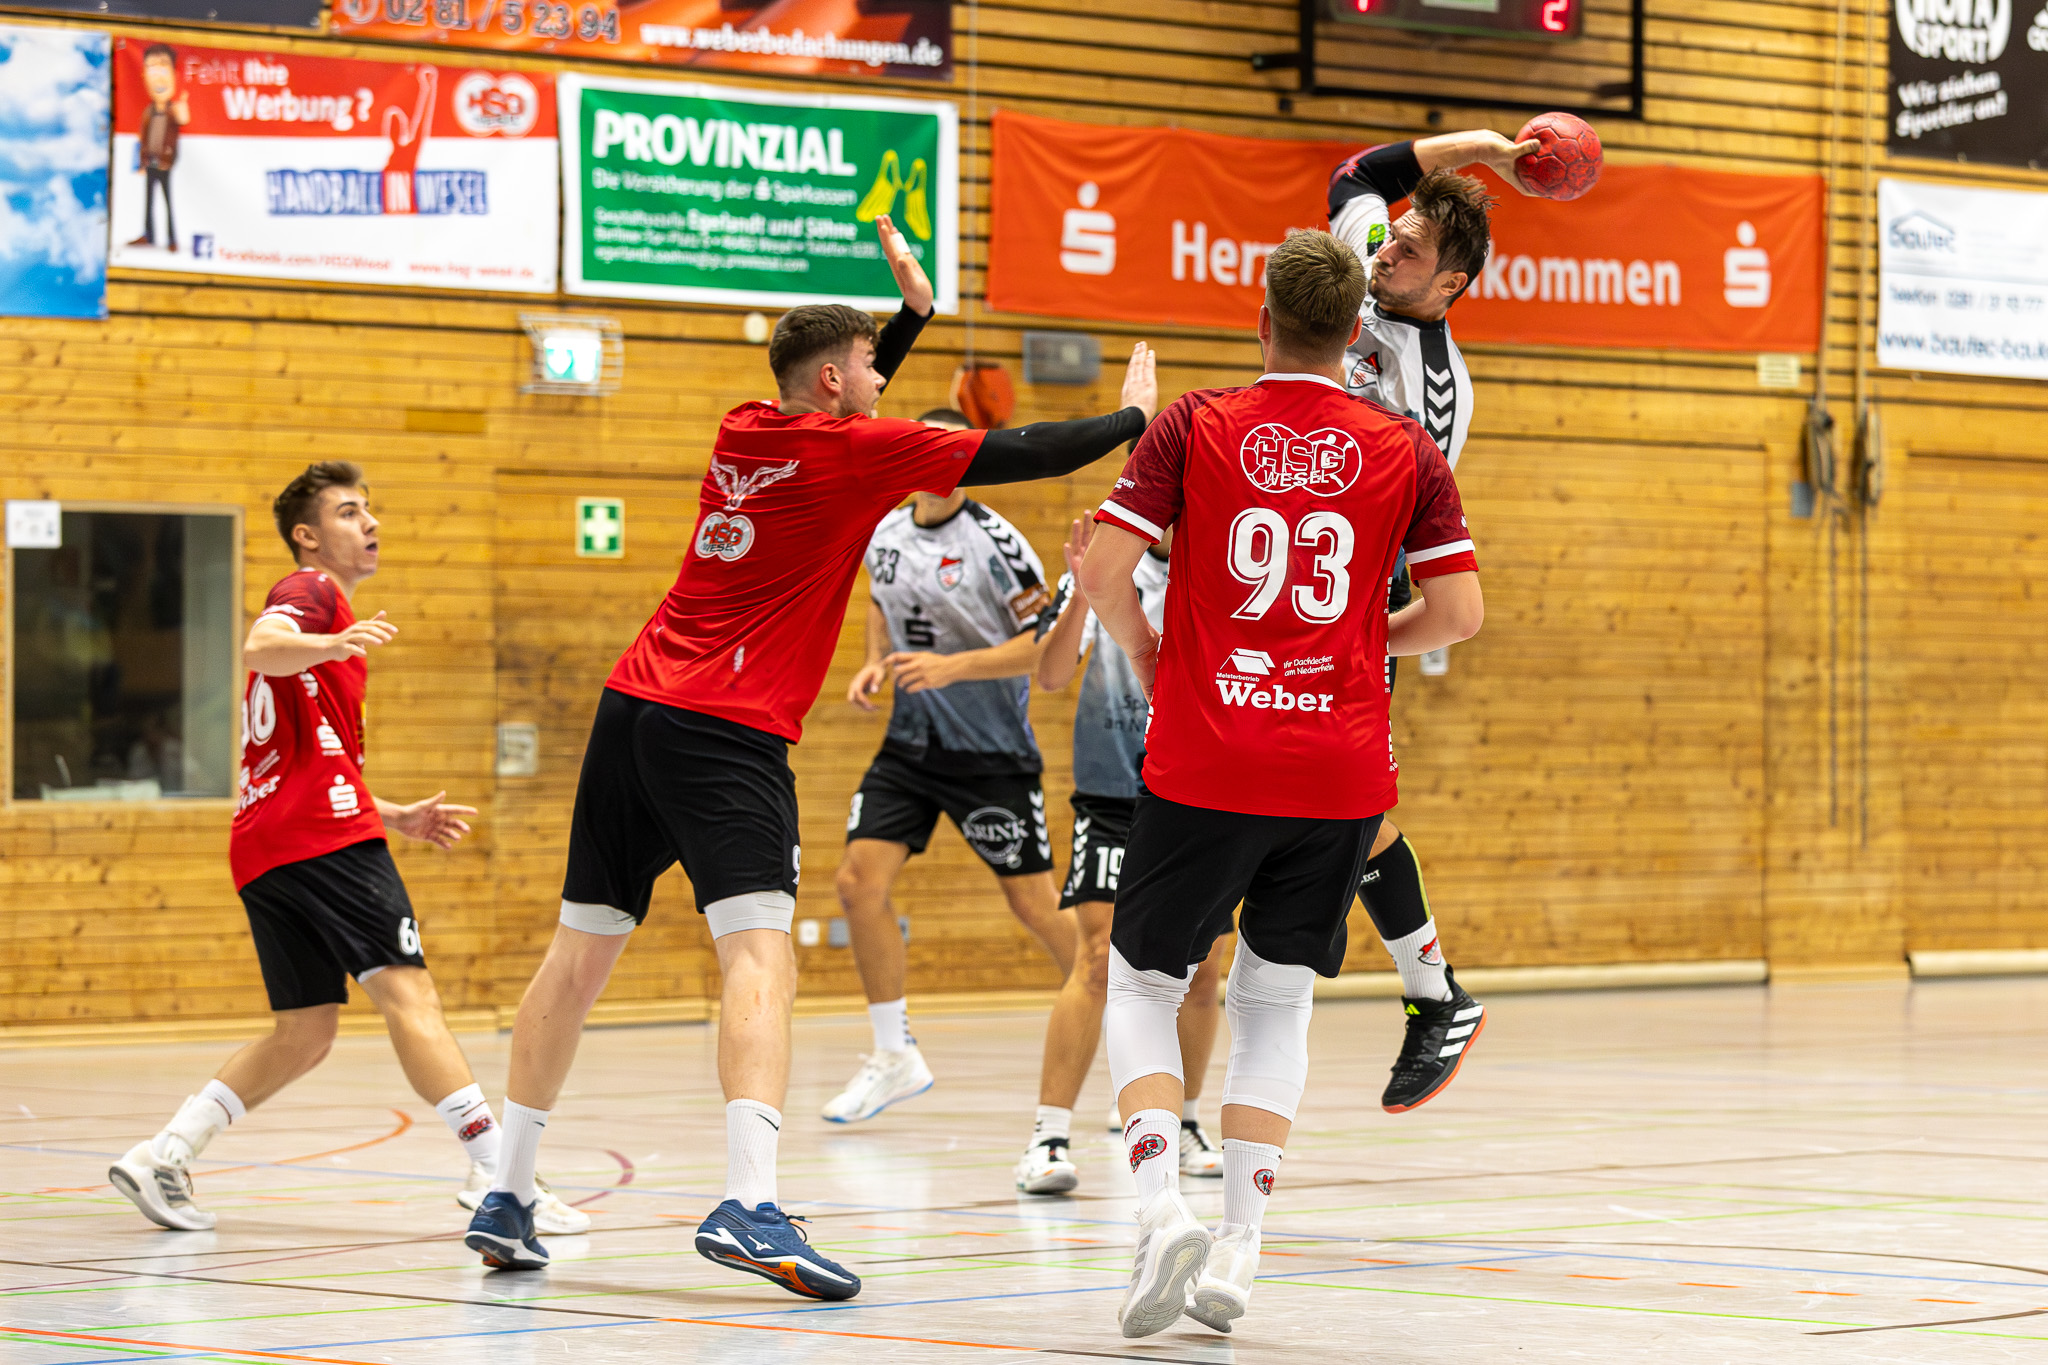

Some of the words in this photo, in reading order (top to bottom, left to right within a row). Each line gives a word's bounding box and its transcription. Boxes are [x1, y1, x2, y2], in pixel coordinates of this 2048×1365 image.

[502, 0, 525, 33] 5
[533, 2, 571, 38] 23
[578, 8, 620, 43] 94
[1914, 23, 1988, 64] SPORT
[222, 86, 374, 131] Werbung?
[592, 109, 858, 177] PROVINZIAL
[267, 170, 382, 215] HANDBALL
[1256, 436, 1346, 475] HSG
[1264, 469, 1330, 487] WESEL
[702, 521, 744, 547] HSG
[1227, 507, 1356, 625] 93
[1215, 679, 1335, 713] Weber
[1216, 671, 1261, 684] Meisterbetrieb
[1096, 846, 1127, 892] 19
[1361, 869, 1380, 884] ECT
